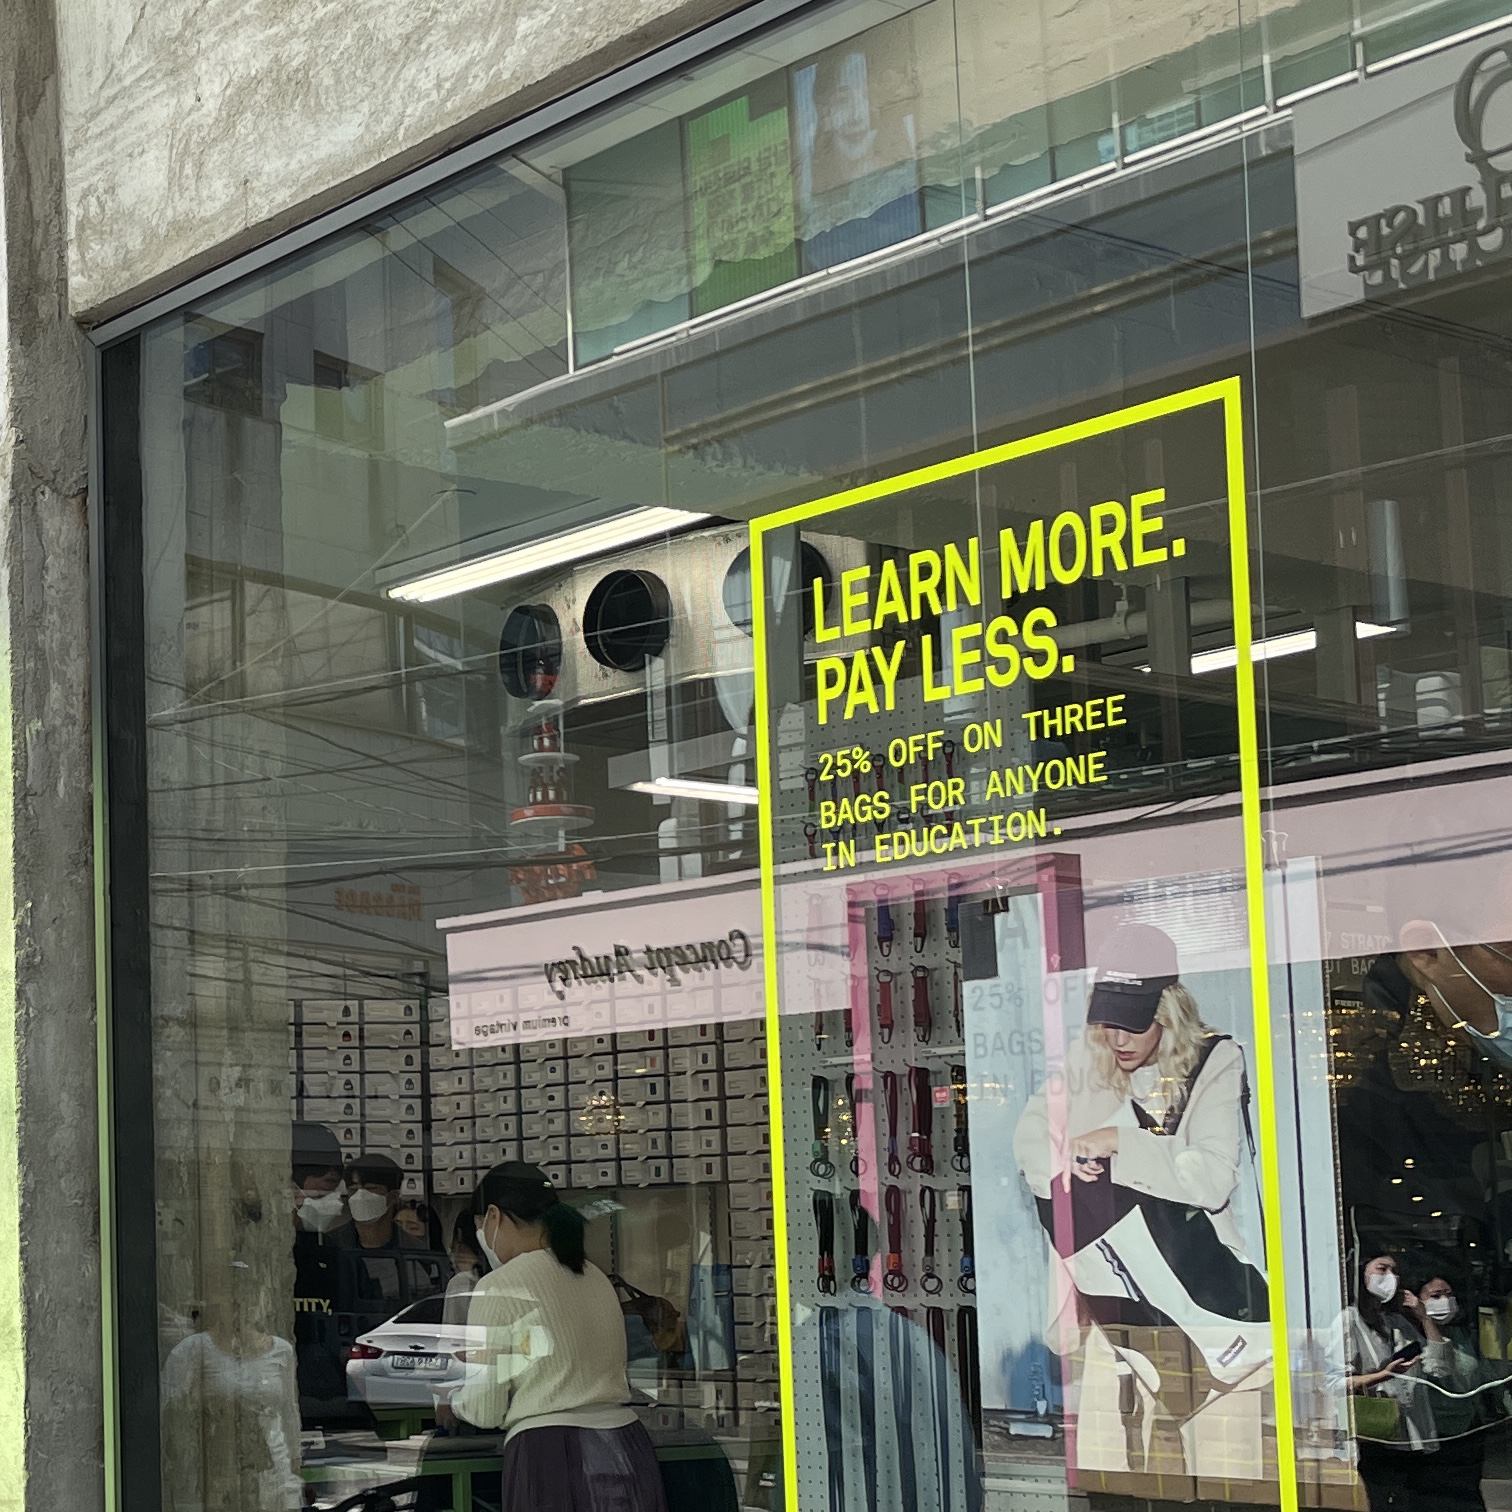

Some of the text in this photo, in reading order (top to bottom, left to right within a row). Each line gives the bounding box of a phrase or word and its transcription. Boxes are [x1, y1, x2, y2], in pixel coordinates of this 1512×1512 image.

[814, 488, 1186, 643] LEARN MORE.
[817, 606, 1076, 724] PAY LESS.
[819, 695, 1127, 781] 25% OFF ON THREE
[819, 751, 1107, 828] BAGS FOR ANYONE
[821, 809, 1065, 871] IN EDUCATION.
